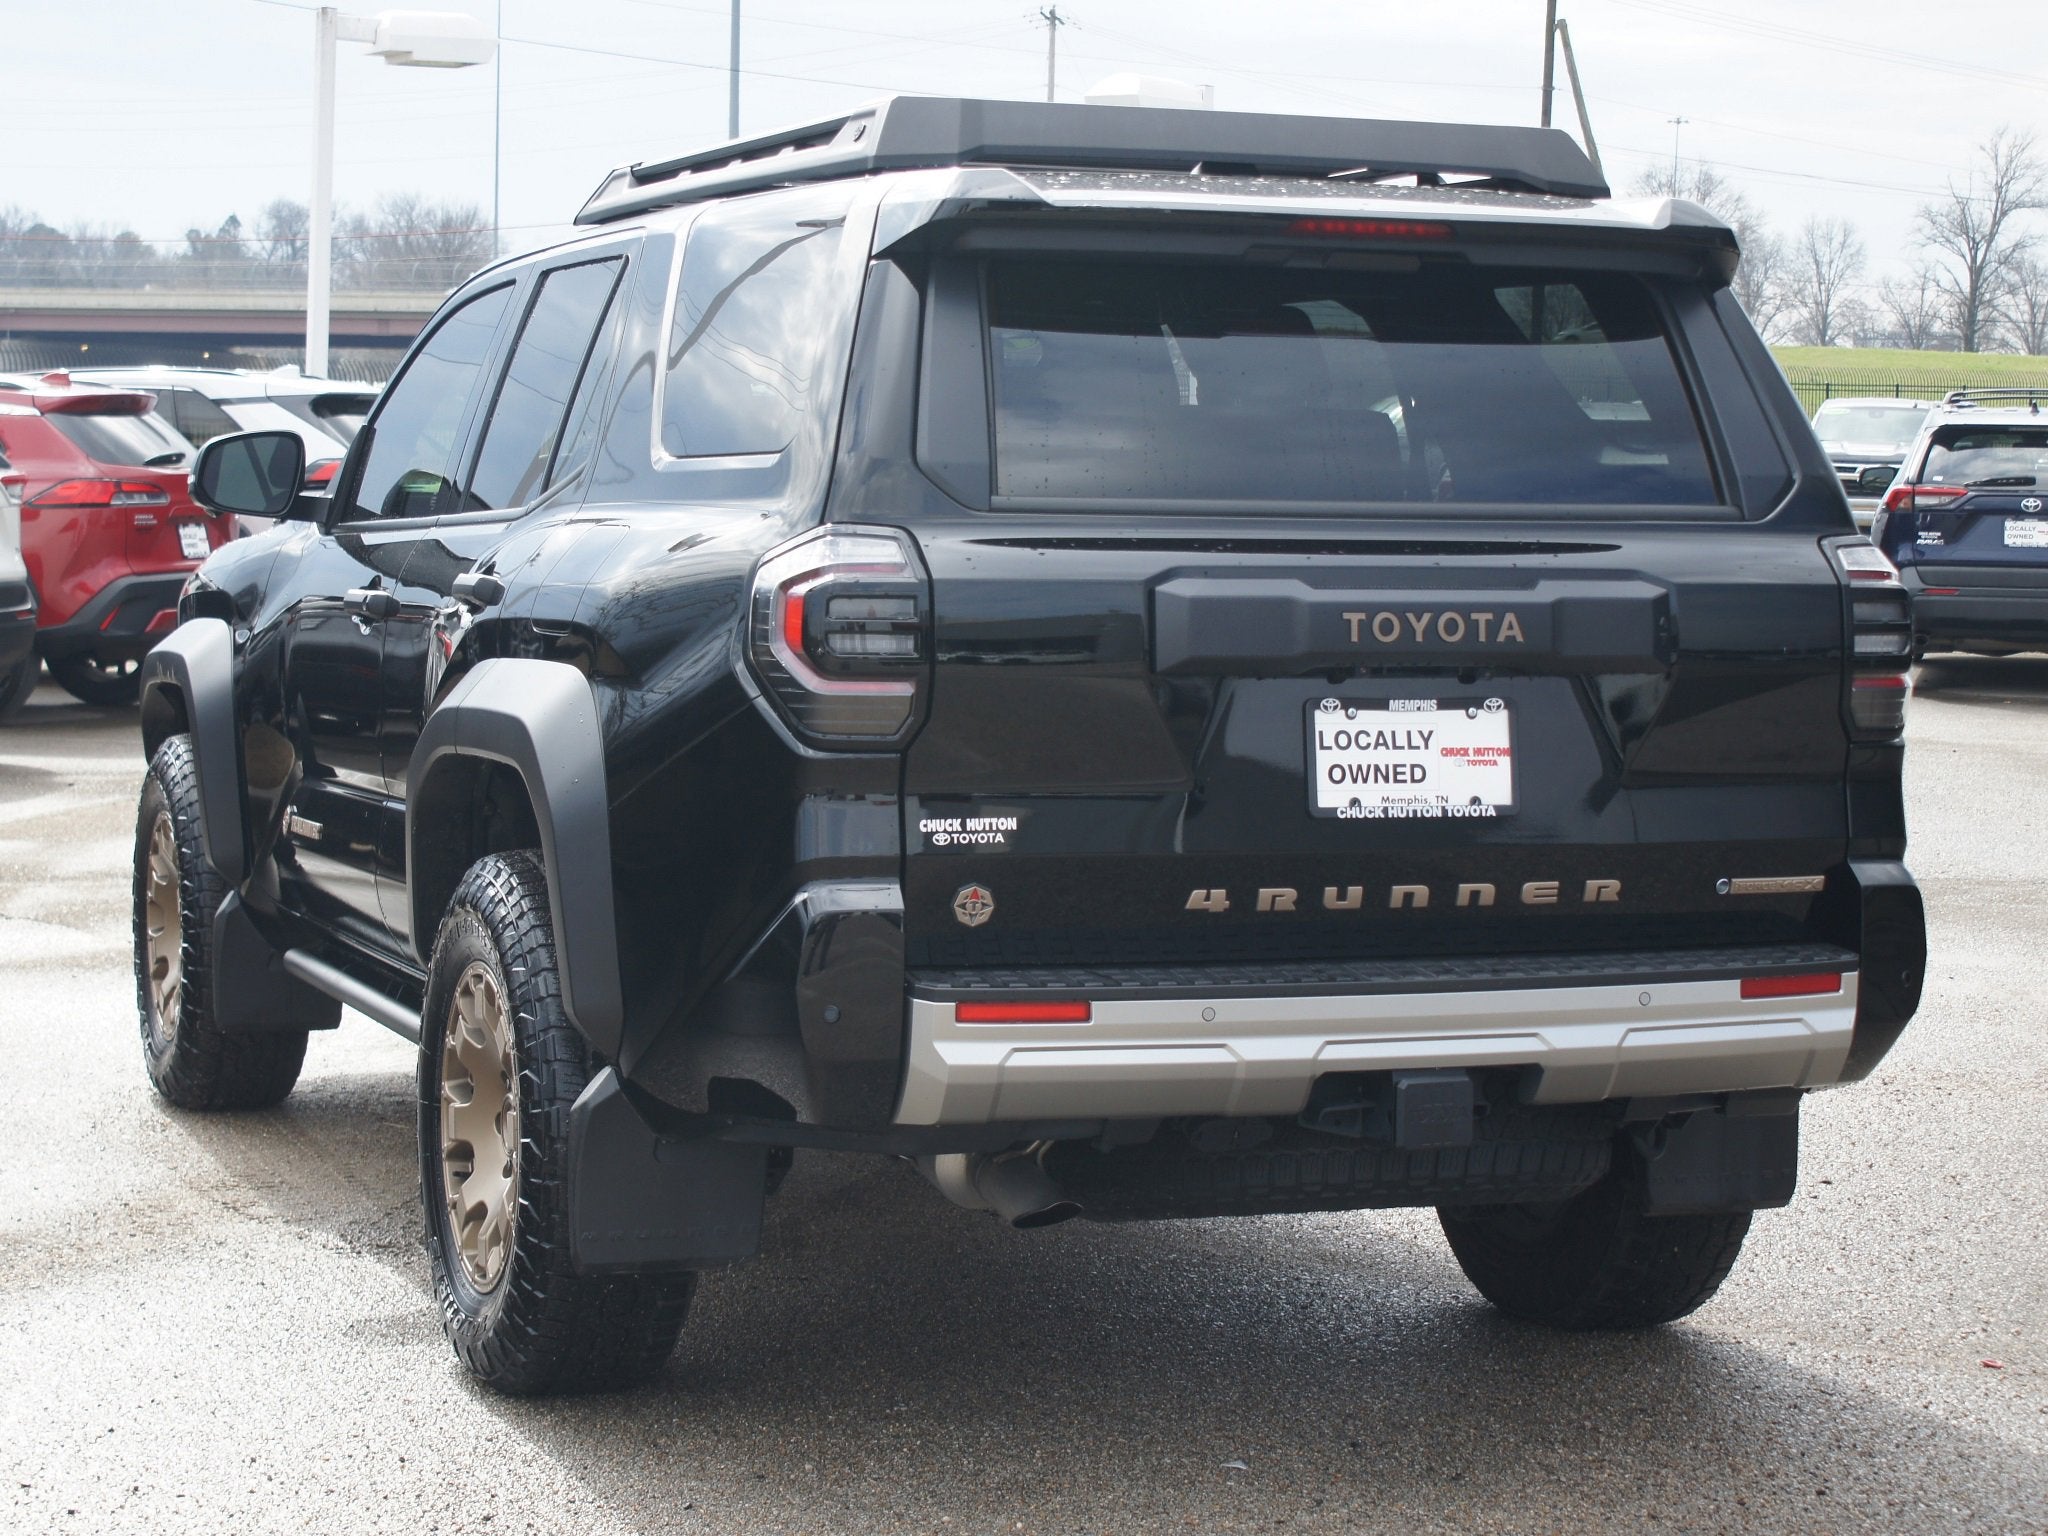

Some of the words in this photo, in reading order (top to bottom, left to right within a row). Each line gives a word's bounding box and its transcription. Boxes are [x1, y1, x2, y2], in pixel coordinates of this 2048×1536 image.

[1342, 611, 1525, 643] TOYOTA
[1389, 699, 1438, 712] MEMPHIS
[1318, 729, 1434, 751] LOCALLY
[1440, 748, 1470, 757] CHUCK
[1473, 747, 1511, 757] HUTTON
[1466, 759, 1498, 767] TOYOTA
[1328, 763, 1427, 785] OWNED
[1381, 795, 1431, 806] Memphis,
[1434, 795, 1449, 804] TN
[1337, 806, 1385, 819] CHUCK
[1387, 806, 1442, 819] HUTTON
[1442, 805, 1497, 818] TOYOTA
[920, 818, 962, 832] CHUCK
[966, 817, 1018, 830] HUTTON
[951, 832, 1005, 844] TOYOTA
[1184, 879, 1622, 912] 4RUNNER
